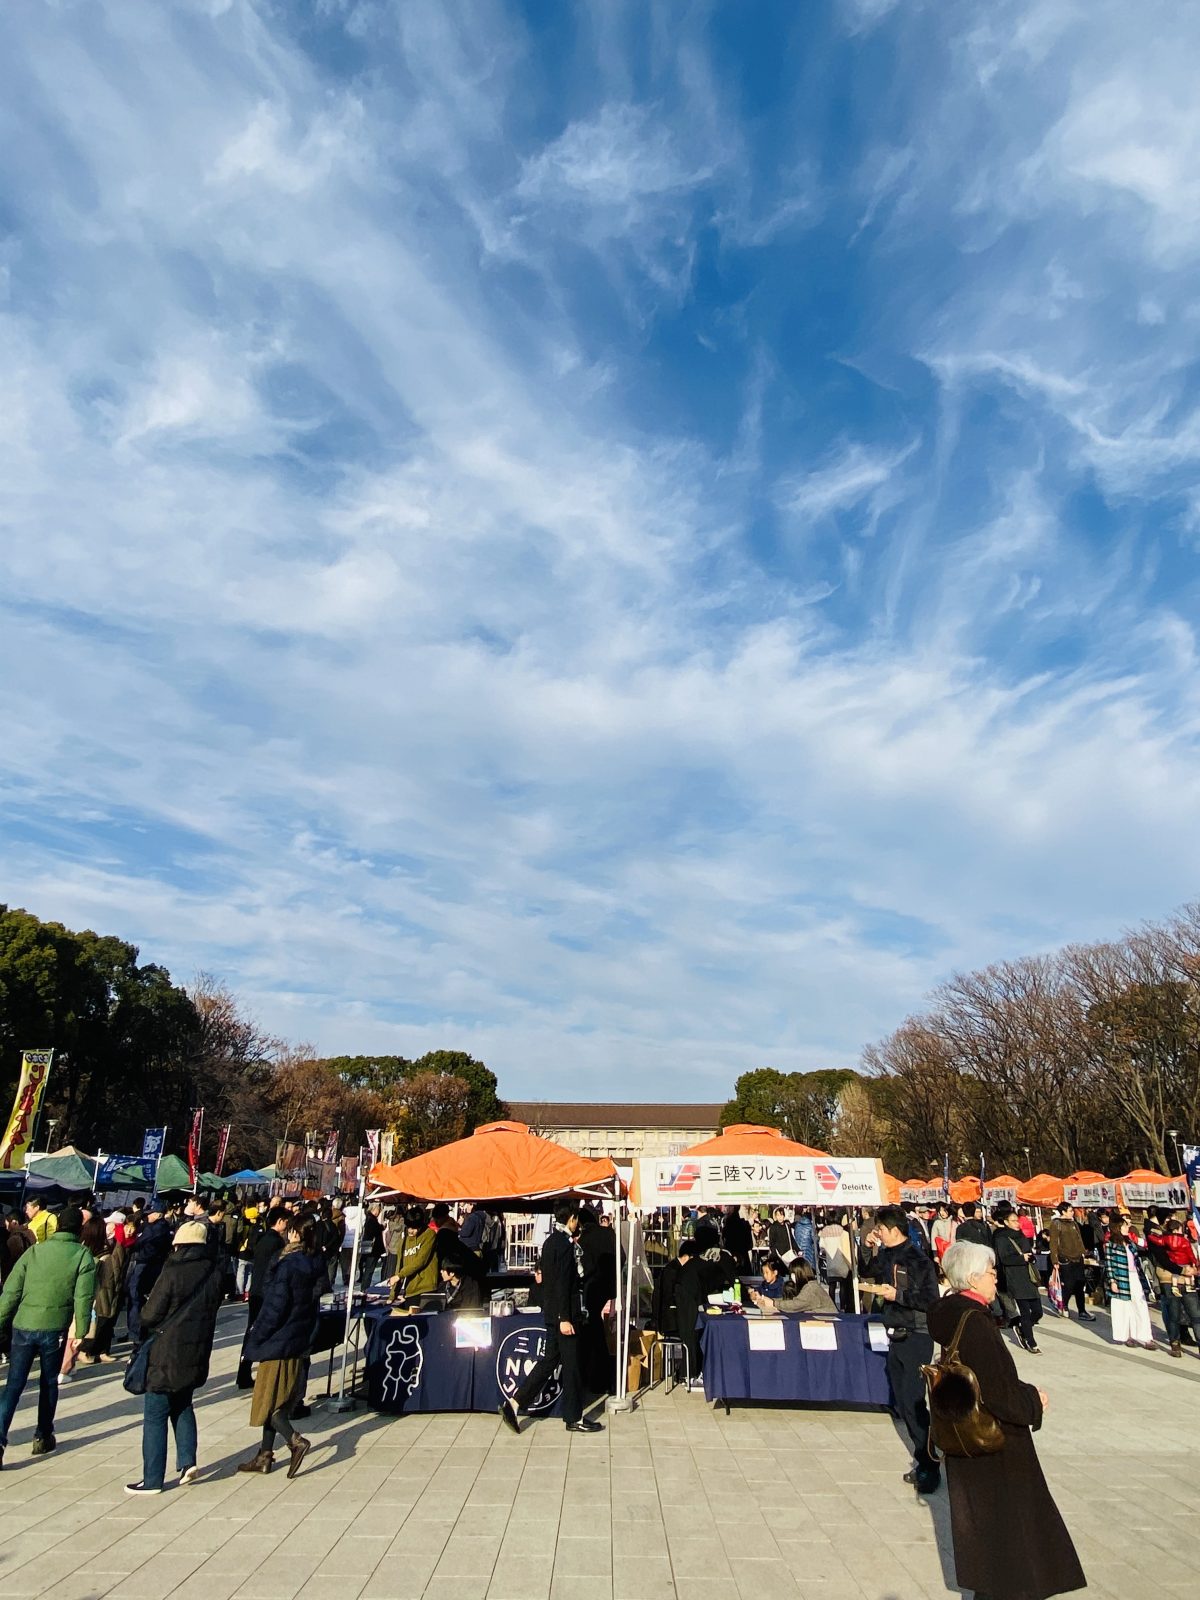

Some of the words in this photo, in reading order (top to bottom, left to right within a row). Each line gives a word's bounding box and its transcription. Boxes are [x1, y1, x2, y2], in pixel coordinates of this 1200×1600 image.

[708, 1165, 807, 1182] 三陸マルシェ
